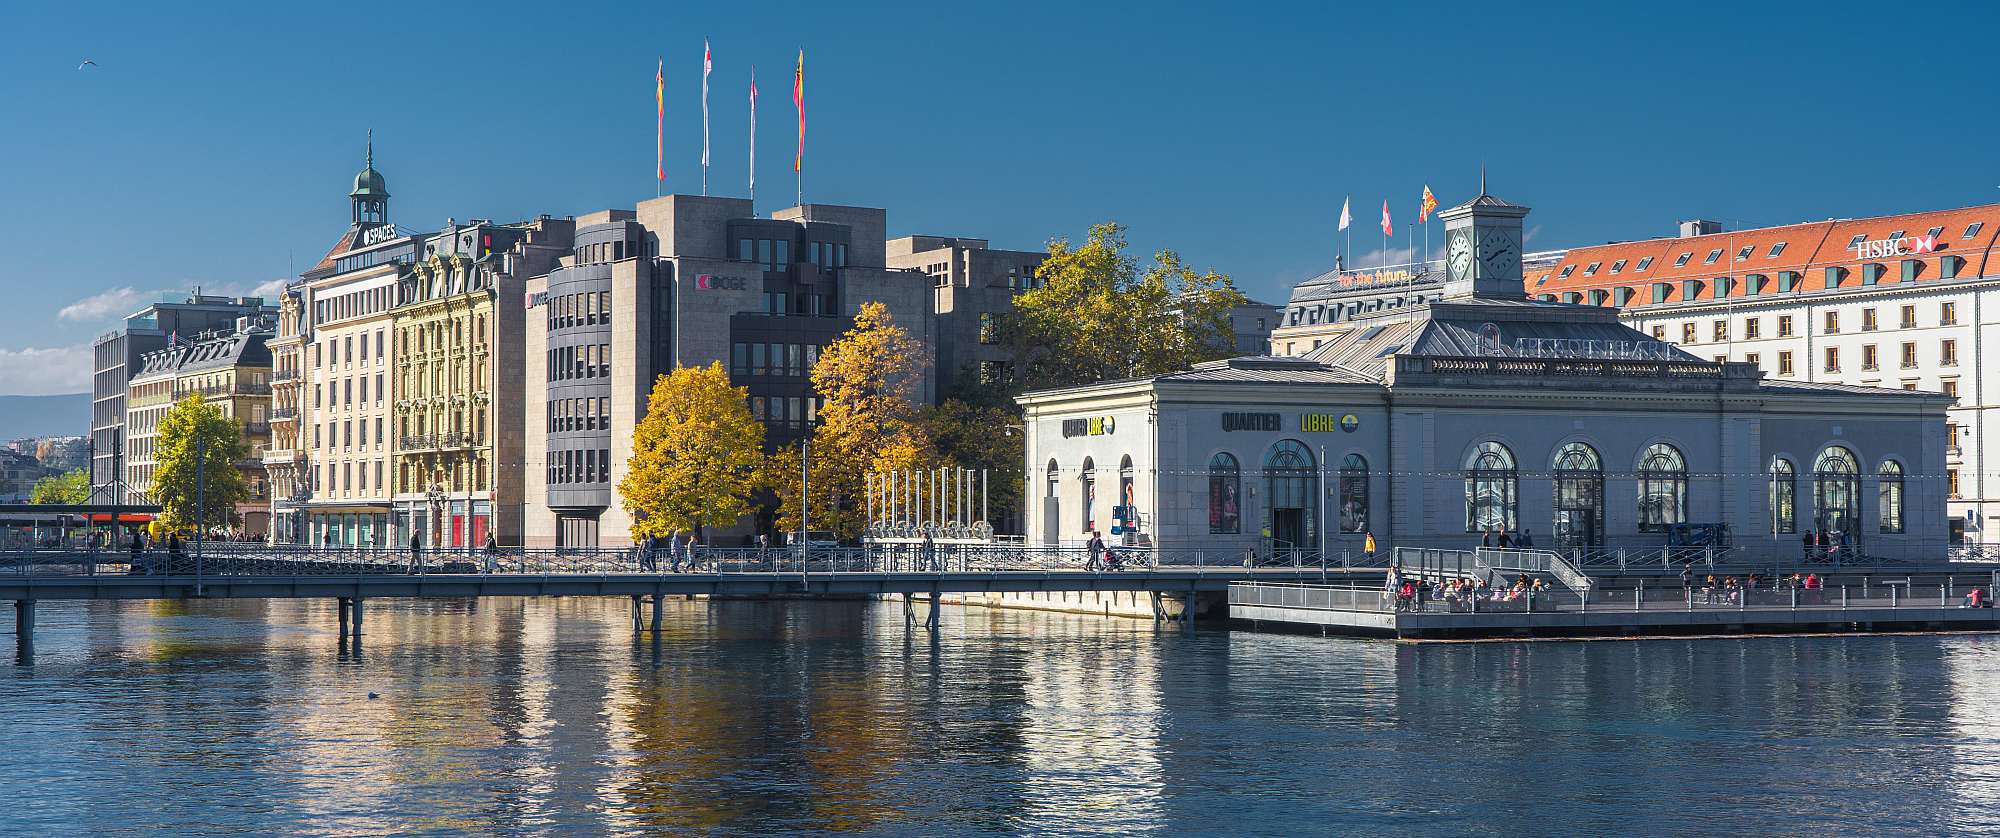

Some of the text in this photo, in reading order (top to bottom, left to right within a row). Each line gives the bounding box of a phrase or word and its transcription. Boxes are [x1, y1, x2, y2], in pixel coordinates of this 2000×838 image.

[1856, 237, 1908, 260] HSBC
[1337, 274, 1353, 288] for
[1356, 271, 1374, 285] the
[1088, 416, 1105, 436] LIBRE
[1221, 412, 1334, 433] QUARTIER LIBRE
